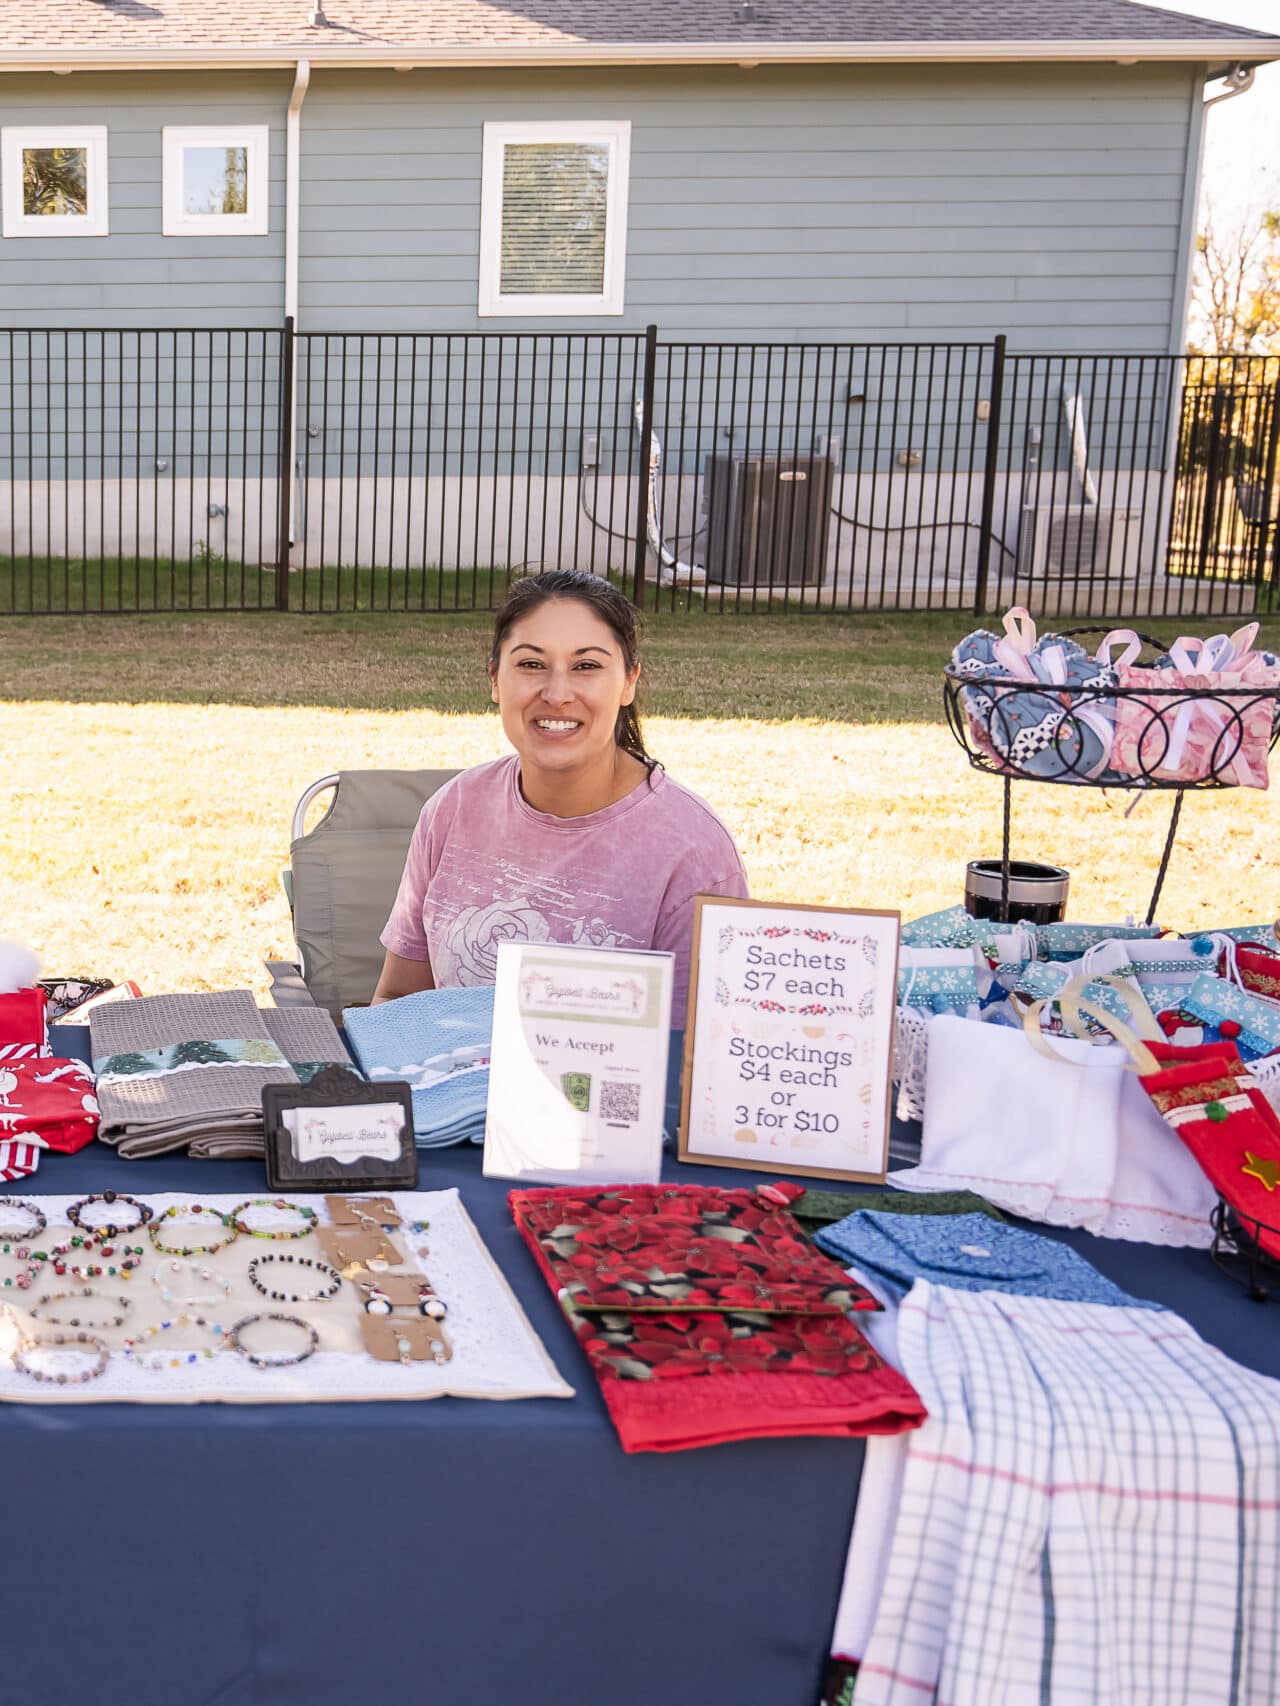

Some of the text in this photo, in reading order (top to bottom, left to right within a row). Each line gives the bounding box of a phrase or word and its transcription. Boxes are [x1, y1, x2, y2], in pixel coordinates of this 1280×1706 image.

[746, 944, 846, 972] Sachets
[743, 970, 844, 998] $7 each
[535, 1033, 615, 1055] We Accept
[729, 1037, 852, 1070] Stockings
[739, 1060, 838, 1088] $4 each
[770, 1090, 797, 1106] or
[734, 1105, 839, 1133] 3 for $10
